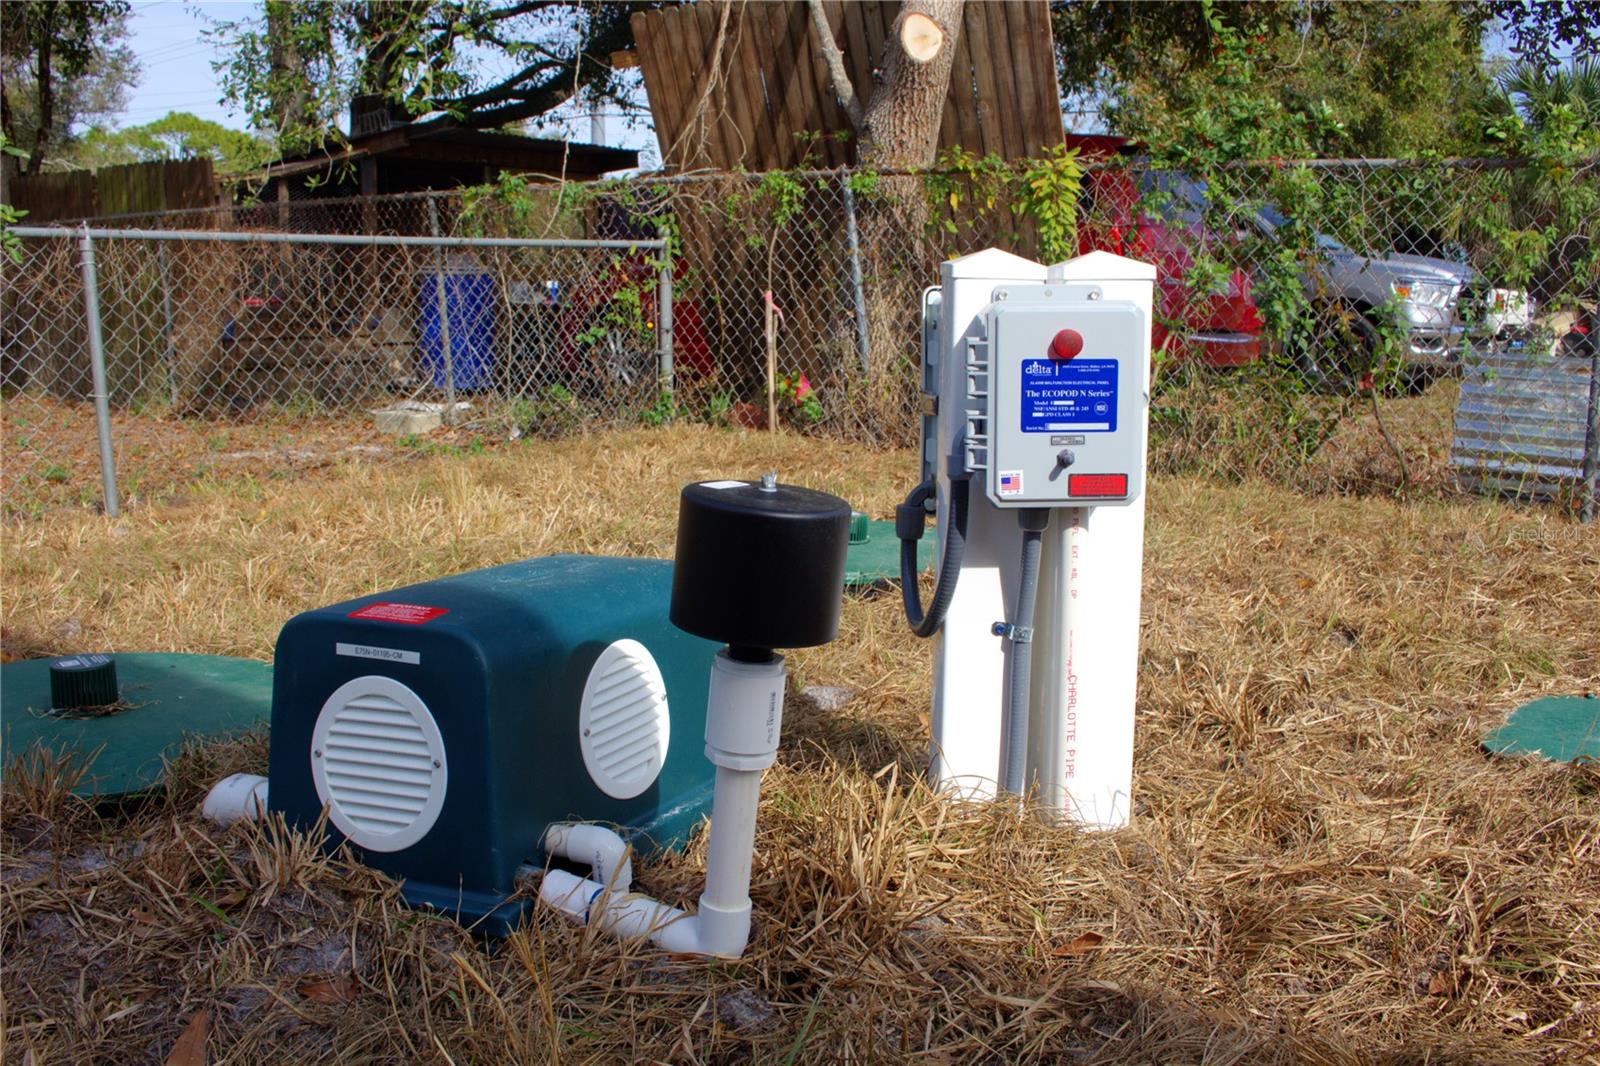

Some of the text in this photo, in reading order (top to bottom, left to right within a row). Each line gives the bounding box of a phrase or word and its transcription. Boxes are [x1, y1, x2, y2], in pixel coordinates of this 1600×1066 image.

[1025, 362, 1052, 375] delta
[1026, 389, 1040, 397] The
[1042, 389, 1078, 397] ECOPOD
[1080, 389, 1086, 397] N
[1066, 674, 1078, 743] CHARLOTTE
[1065, 749, 1077, 779] PIPE
